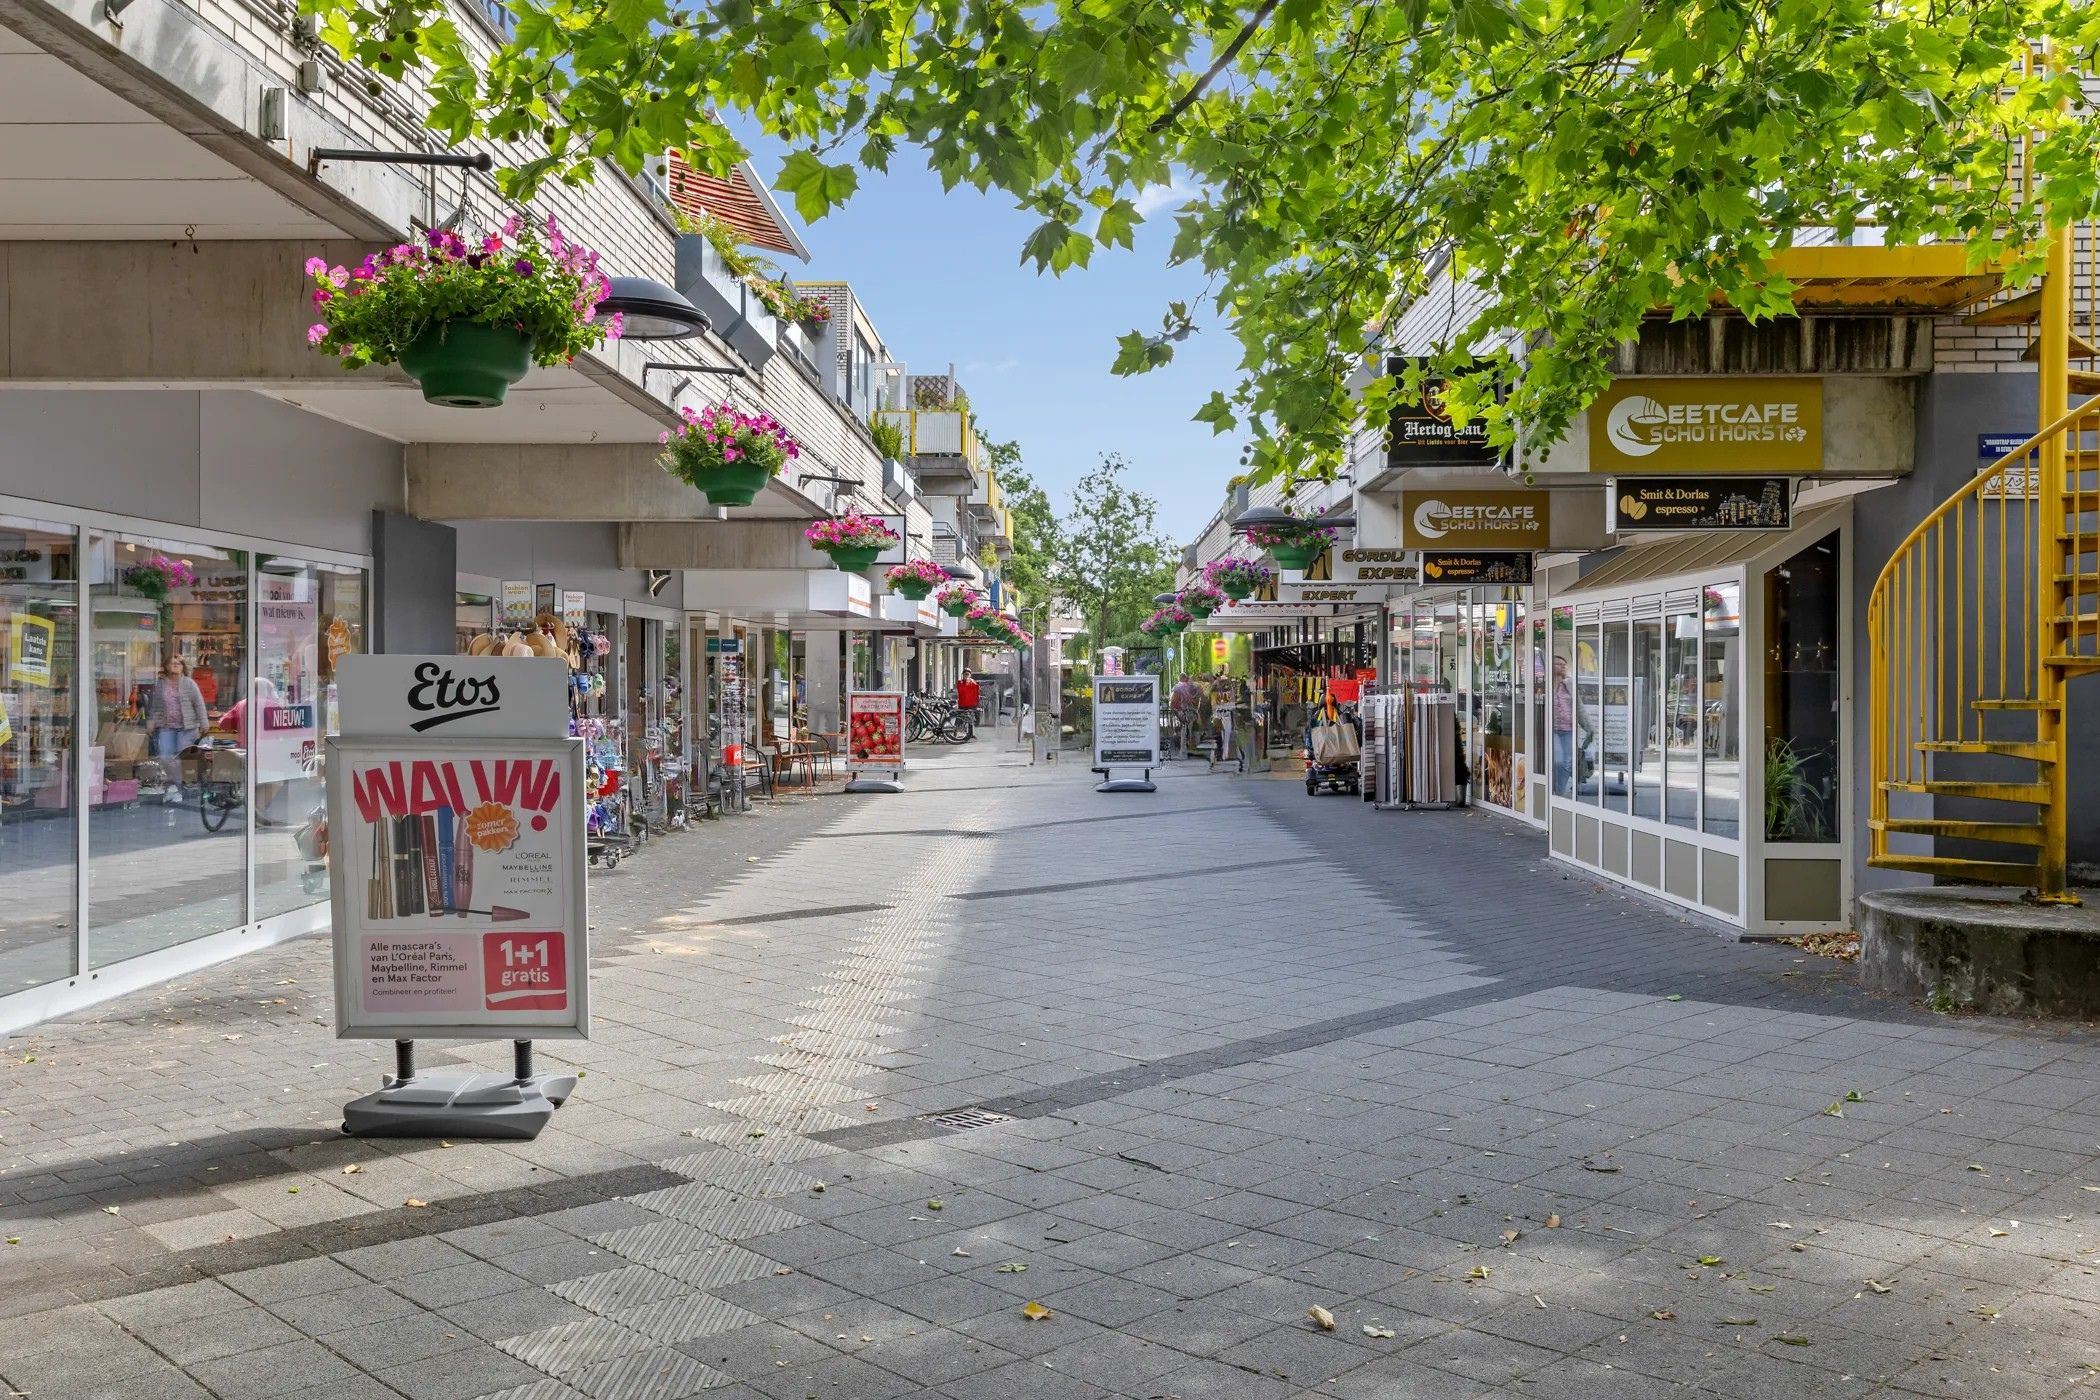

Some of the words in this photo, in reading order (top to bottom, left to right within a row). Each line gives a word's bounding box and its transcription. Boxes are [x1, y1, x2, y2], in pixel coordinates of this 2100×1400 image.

[1668, 403, 1799, 424] EETCAFE
[1404, 421, 1453, 440] Hertog
[1650, 424, 1787, 443] SCHOTHORST
[1640, 488, 1664, 500] Smit
[1664, 488, 1674, 500] &
[1675, 488, 1710, 500] Dorlas
[1452, 506, 1535, 519] EETCAFE
[1655, 504, 1699, 516] espresso
[1440, 520, 1527, 531] SCHOTHORST
[1438, 558, 1453, 567] Smit
[1358, 567, 1418, 579] EXPER
[1447, 568, 1475, 577] espresso
[1302, 590, 1357, 600] EXPERT
[24, 632, 47, 646] Laatste
[28, 643, 43, 655] kans
[407, 662, 501, 711] Etos
[273, 708, 304, 728] NIEUW!
[353, 759, 560, 833] WAUW!
[370, 943, 390, 951] Alle
[392, 942, 442, 951] mascara's
[371, 954, 388, 962] van
[429, 952, 456, 962] Paris,
[500, 939, 549, 967] 1+1
[371, 963, 427, 974] Maybelline,
[430, 963, 467, 972] Rimmel
[372, 975, 385, 983] en
[387, 974, 408, 983] Max
[410, 973, 442, 982] Factor
[501, 969, 550, 987] gratis
[372, 988, 412, 996] Combineer
